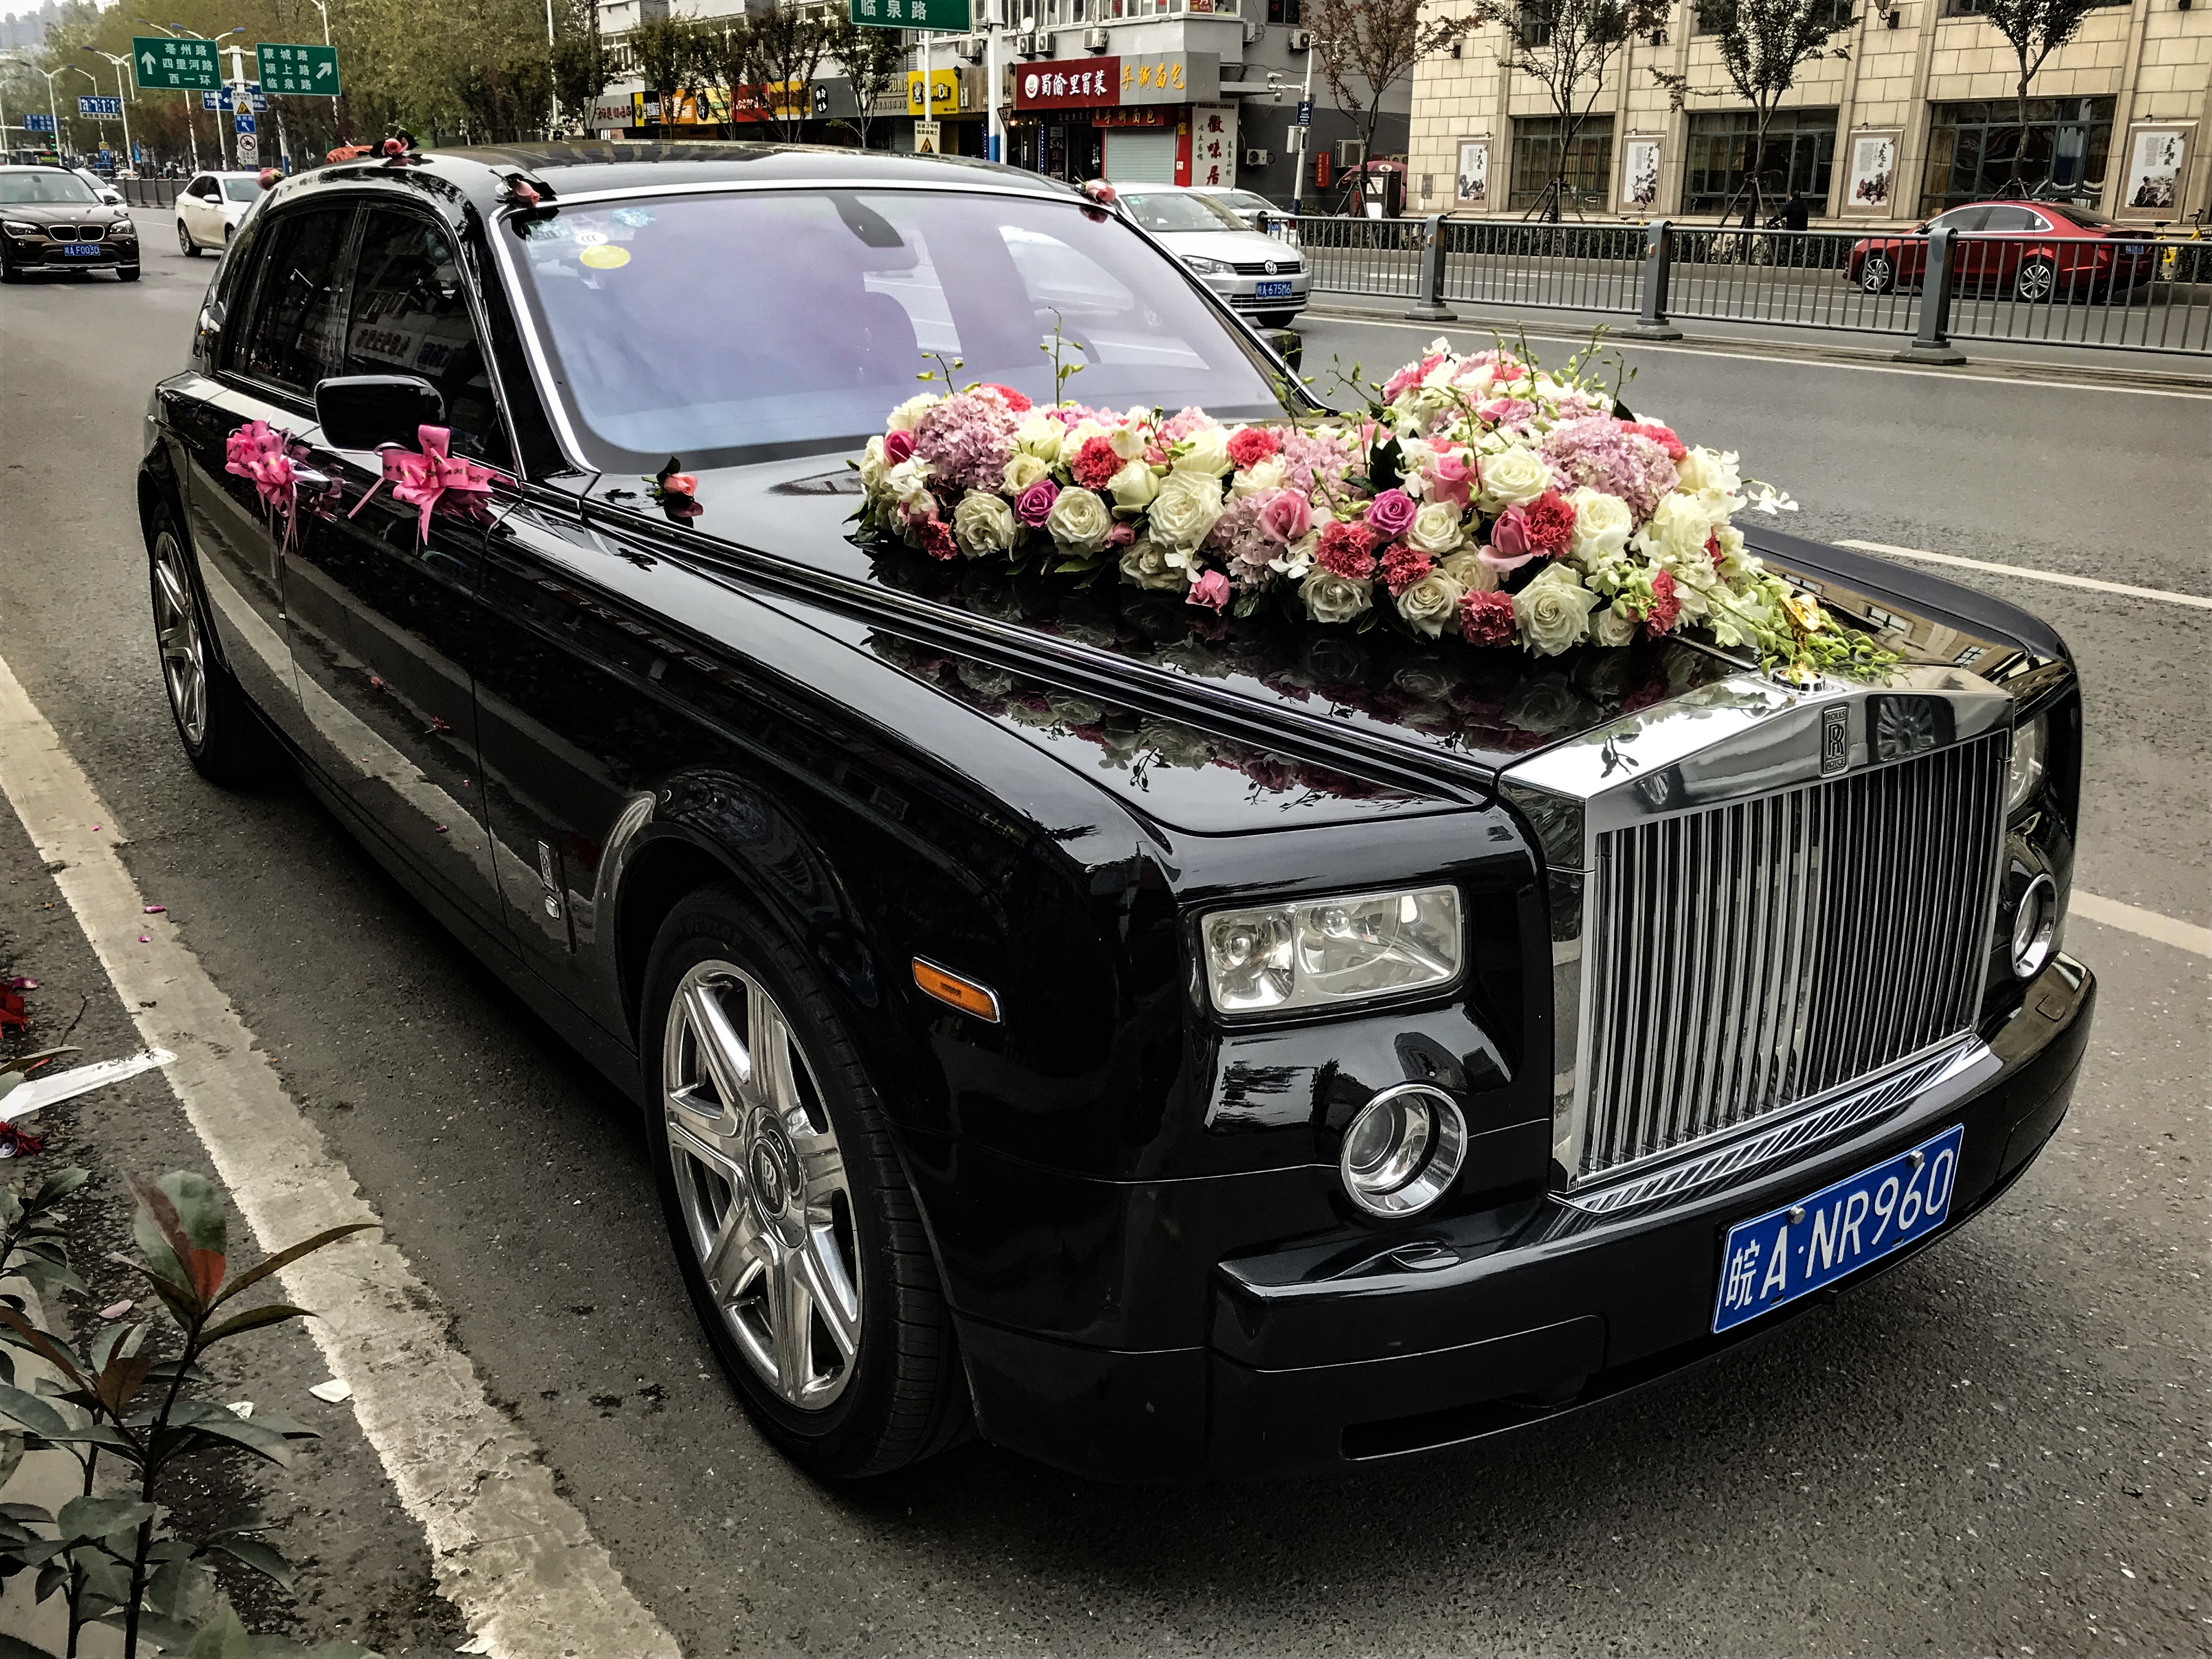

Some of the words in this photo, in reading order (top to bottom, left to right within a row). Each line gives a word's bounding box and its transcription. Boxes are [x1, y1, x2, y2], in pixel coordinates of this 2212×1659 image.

[861, 0, 927, 20] 临泉路
[162, 58, 213, 71] 四里河路
[168, 73, 211, 86] 西一环
[267, 78, 311, 90] 临泉路
[1041, 70, 1107, 97] 蜀渝里冒菜
[1002, 110, 1009, 121] 让
[1827, 710, 1846, 722] ROLLS
[1826, 758, 1846, 769] ROYCE
